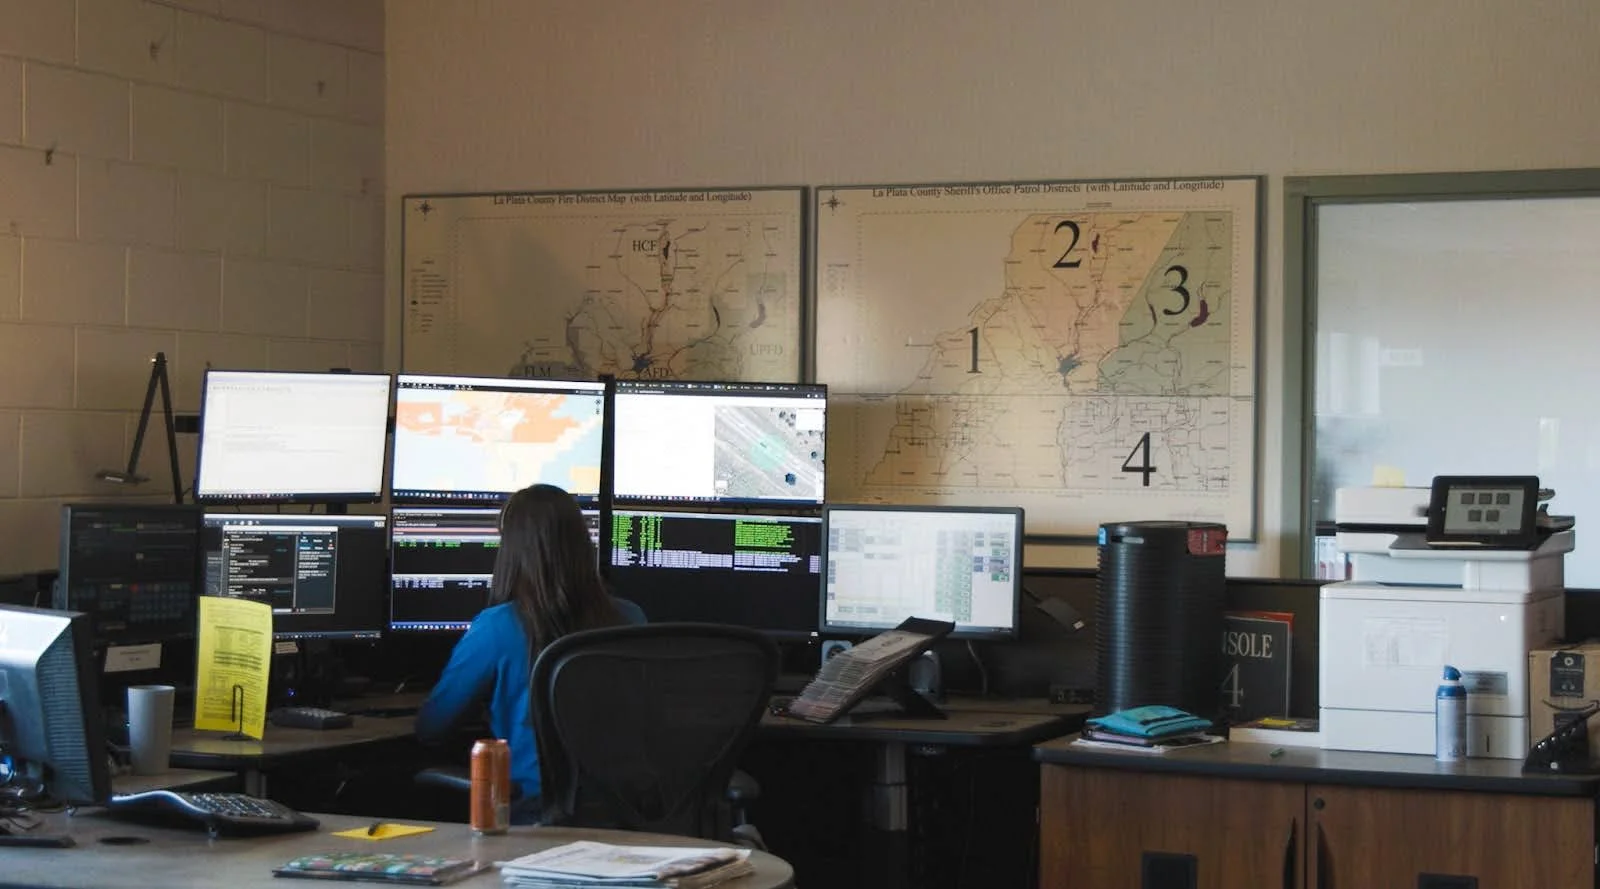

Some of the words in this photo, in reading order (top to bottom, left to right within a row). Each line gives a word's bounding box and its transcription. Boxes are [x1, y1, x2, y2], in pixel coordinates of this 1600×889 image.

[494, 194, 504, 205] La
[506, 193, 526, 205] Plata
[527, 193, 557, 207] County
[559, 193, 576, 204] Fire
[577, 193, 606, 204] District
[607, 193, 626, 205] Map
[630, 192, 652, 204] (with
[654, 191, 687, 202] Latitude
[689, 191, 704, 201] and
[706, 191, 753, 204] Longitude)
[872, 187, 884, 197] La
[886, 186, 908, 197] Plata
[910, 185, 941, 198] County
[944, 184, 980, 196] Sheriff's
[982, 183, 1011, 195] Office
[1014, 182, 1040, 194] Patrol
[1043, 182, 1081, 193] Districts
[1086, 181, 1110, 193] (with
[1113, 180, 1151, 192] Latitude
[1153, 180, 1170, 191] and
[1173, 179, 1225, 192] Longitude)
[1052, 220, 1082, 268] 2
[1163, 265, 1190, 315] 3
[966, 327, 983, 374] 1
[1121, 431, 1157, 487] 4
[1221, 663, 1244, 708] 4
